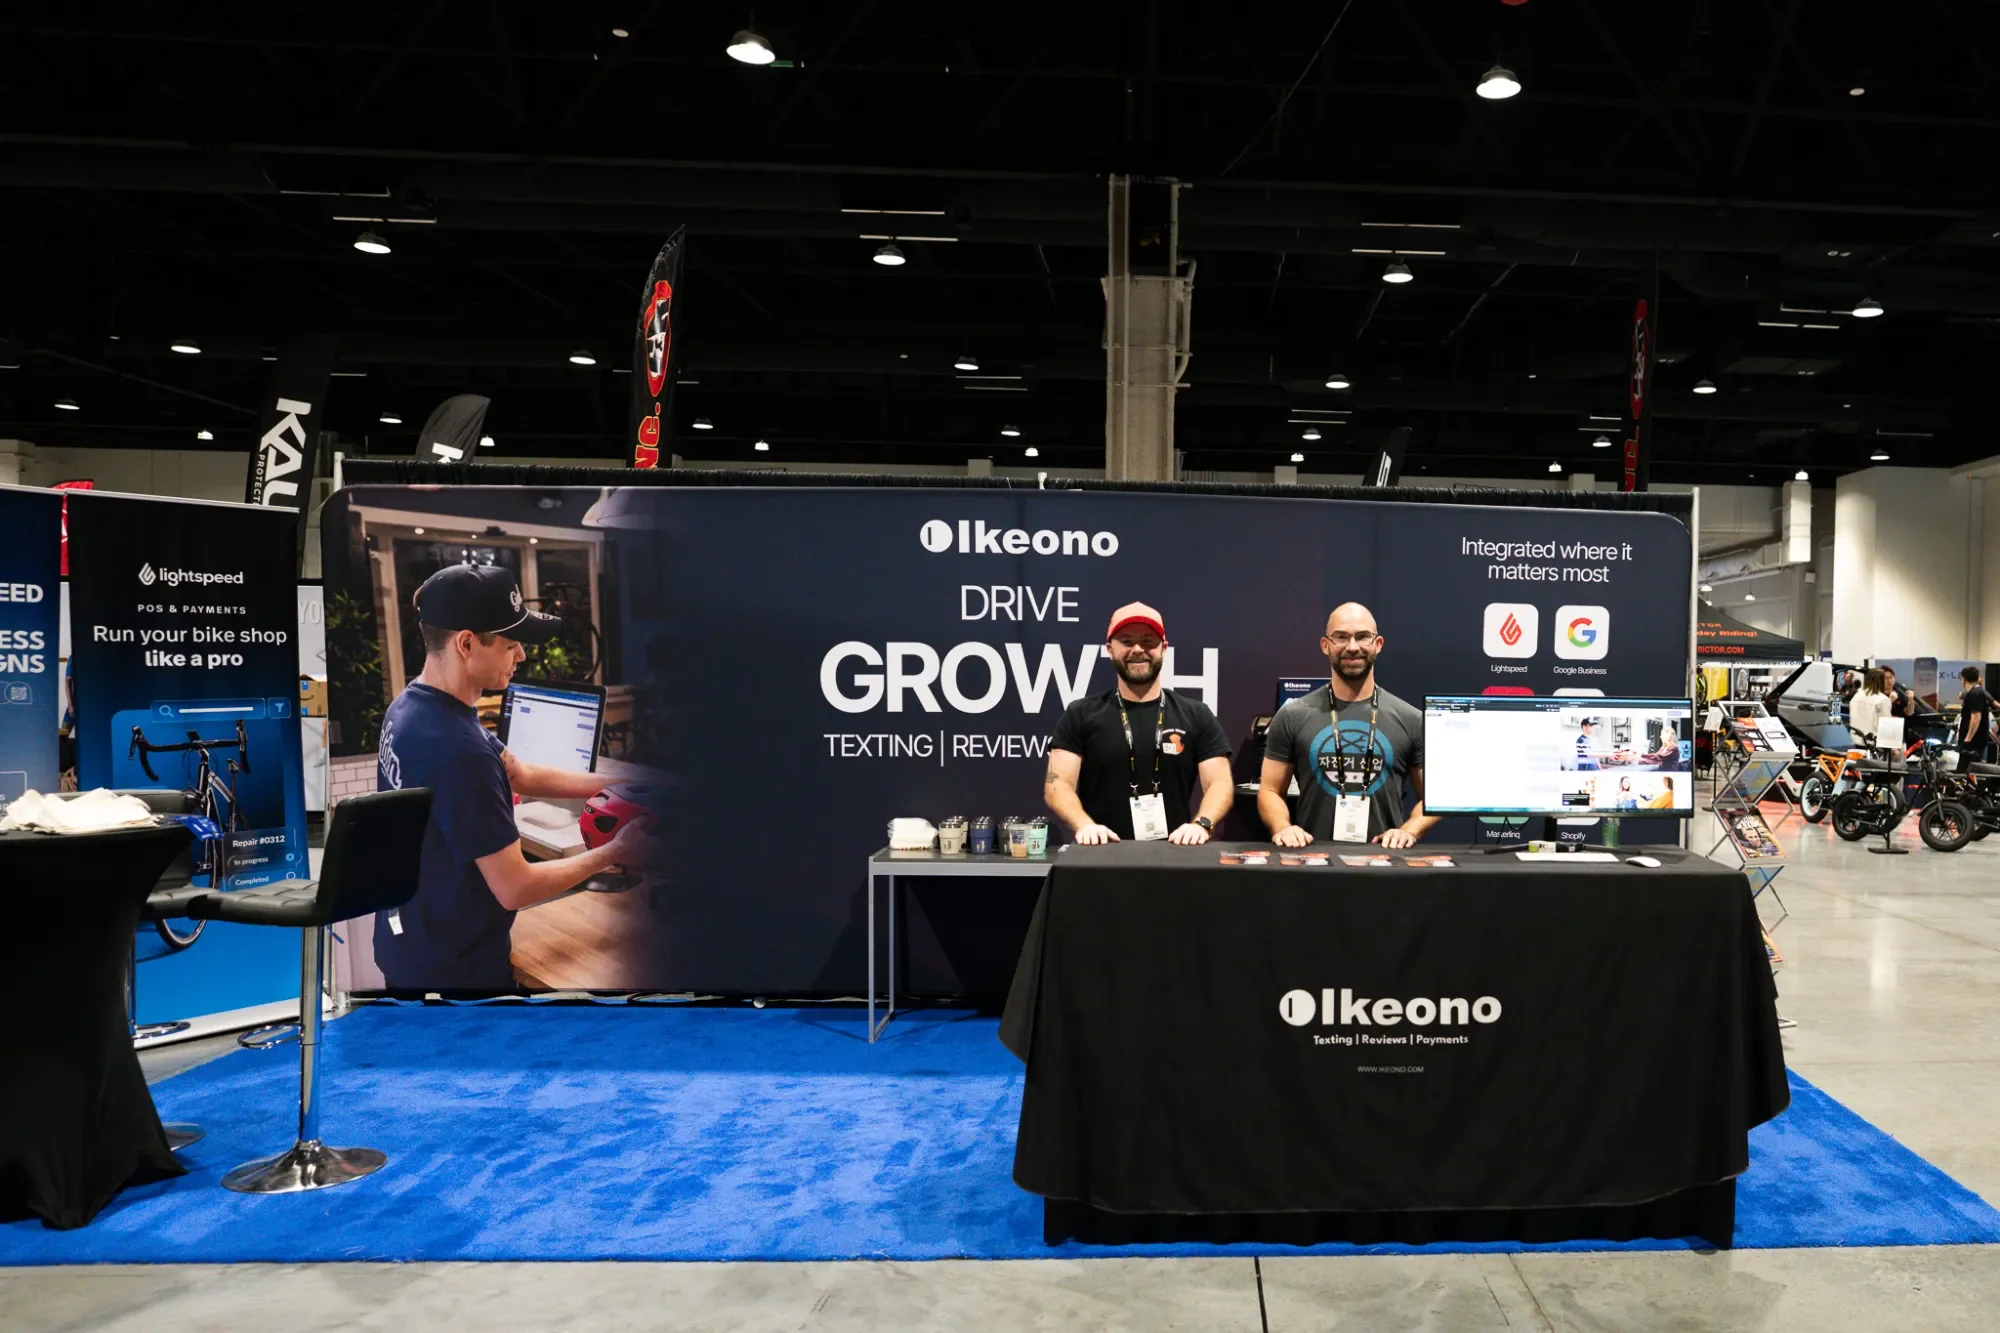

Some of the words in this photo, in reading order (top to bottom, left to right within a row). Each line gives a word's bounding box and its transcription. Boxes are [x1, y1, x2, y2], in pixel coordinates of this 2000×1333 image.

[957, 519, 1120, 558] Ikeono
[1461, 536, 1556, 562] Integrated
[1559, 541, 1618, 561] where
[1621, 542, 1633, 561] it
[159, 567, 244, 587] lightspeed
[1488, 563, 1559, 582] matters
[1562, 565, 1610, 583] most
[137, 603, 164, 614] POS
[168, 604, 178, 614] &
[182, 604, 247, 616] PAYMENTS
[960, 584, 1080, 623] DRIVE
[93, 625, 135, 643] Run
[140, 629, 188, 647] your
[192, 626, 235, 644] bike
[239, 627, 288, 647] shop
[145, 649, 186, 668] like
[190, 653, 203, 668] a
[207, 653, 244, 670] pro
[819, 640, 1219, 718] GROWH
[1490, 664, 1528, 675] Lightspeed
[1553, 665, 1577, 677] Google
[1577, 667, 1608, 676] Business
[823, 733, 934, 758] TEXTING
[952, 734, 1053, 758] REVIEW
[232, 838, 258, 849] Repair
[259, 835, 286, 846] #0312
[1560, 831, 1586, 842] Shopify
[243, 856, 269, 867] progress
[234, 876, 270, 887] Completed
[1321, 988, 1502, 1026] Ikeono
[1313, 1034, 1353, 1046] Texting
[1361, 1034, 1408, 1045] Reviews
[1416, 1034, 1469, 1047] Payments
[1357, 1065, 1425, 1074] WWW.IKEONO.COM
